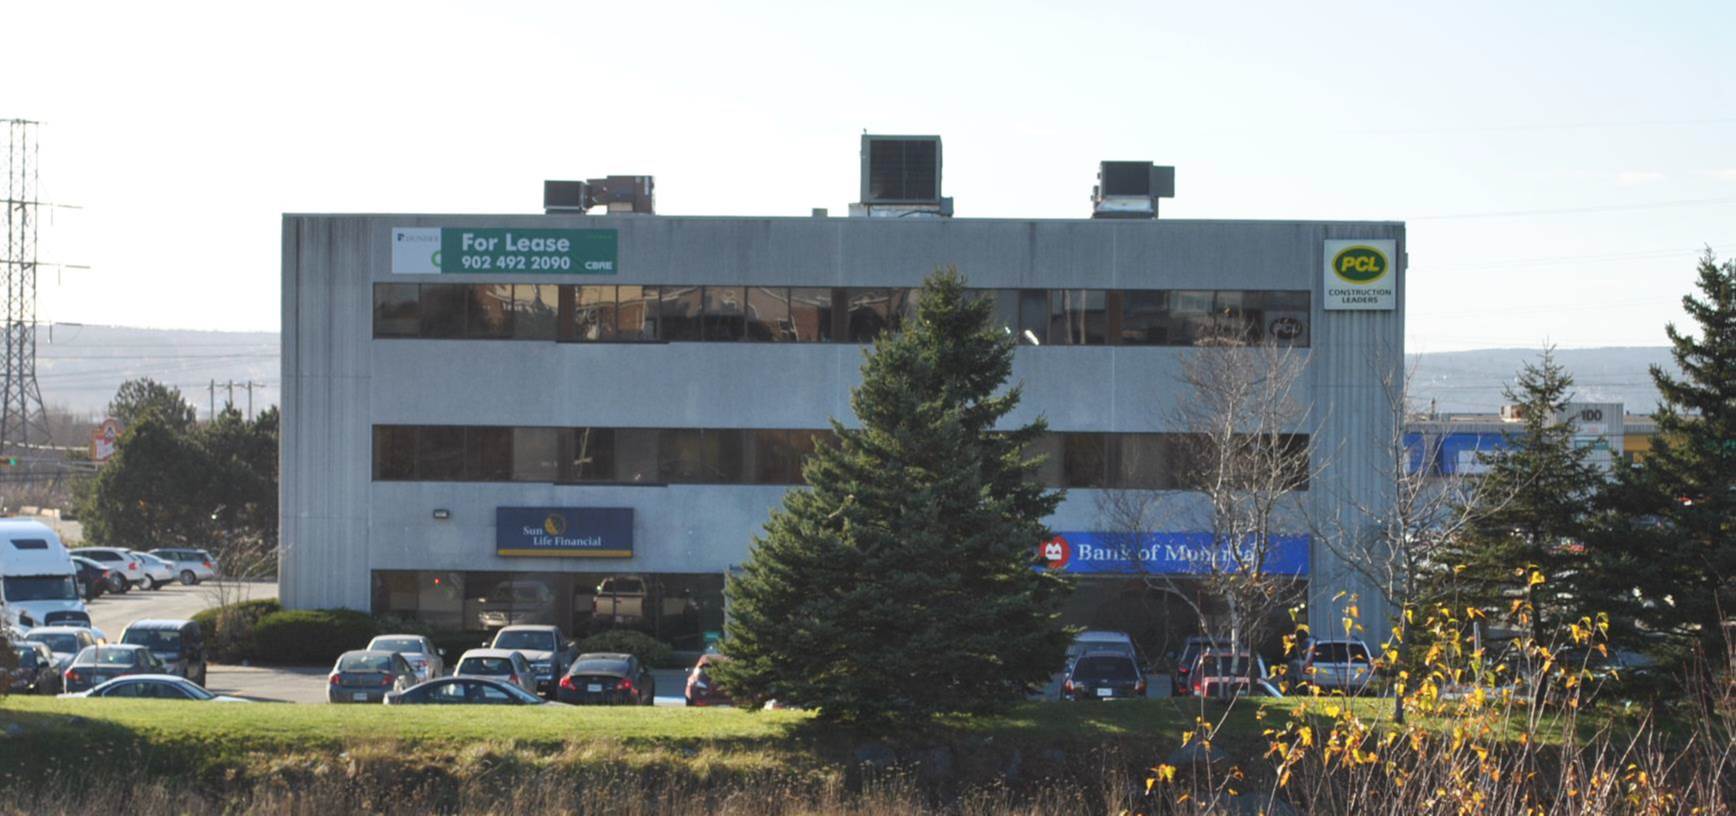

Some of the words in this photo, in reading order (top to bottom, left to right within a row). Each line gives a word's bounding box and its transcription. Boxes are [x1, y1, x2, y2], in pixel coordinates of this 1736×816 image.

[462, 233, 499, 252] For
[505, 233, 571, 252] Lease
[462, 256, 492, 270] 902
[496, 256, 526, 270] 492
[531, 256, 571, 270] 2090
[1341, 256, 1380, 272] PCL
[1328, 289, 1392, 297] CONSTRUCTION
[1581, 409, 1602, 421] 100
[523, 526, 543, 536] Sun
[533, 536, 552, 546] Life
[555, 536, 602, 546] Financial
[1078, 543, 1132, 560] Bank
[1138, 543, 1161, 560] of
[1165, 544, 1259, 561] Monrea
